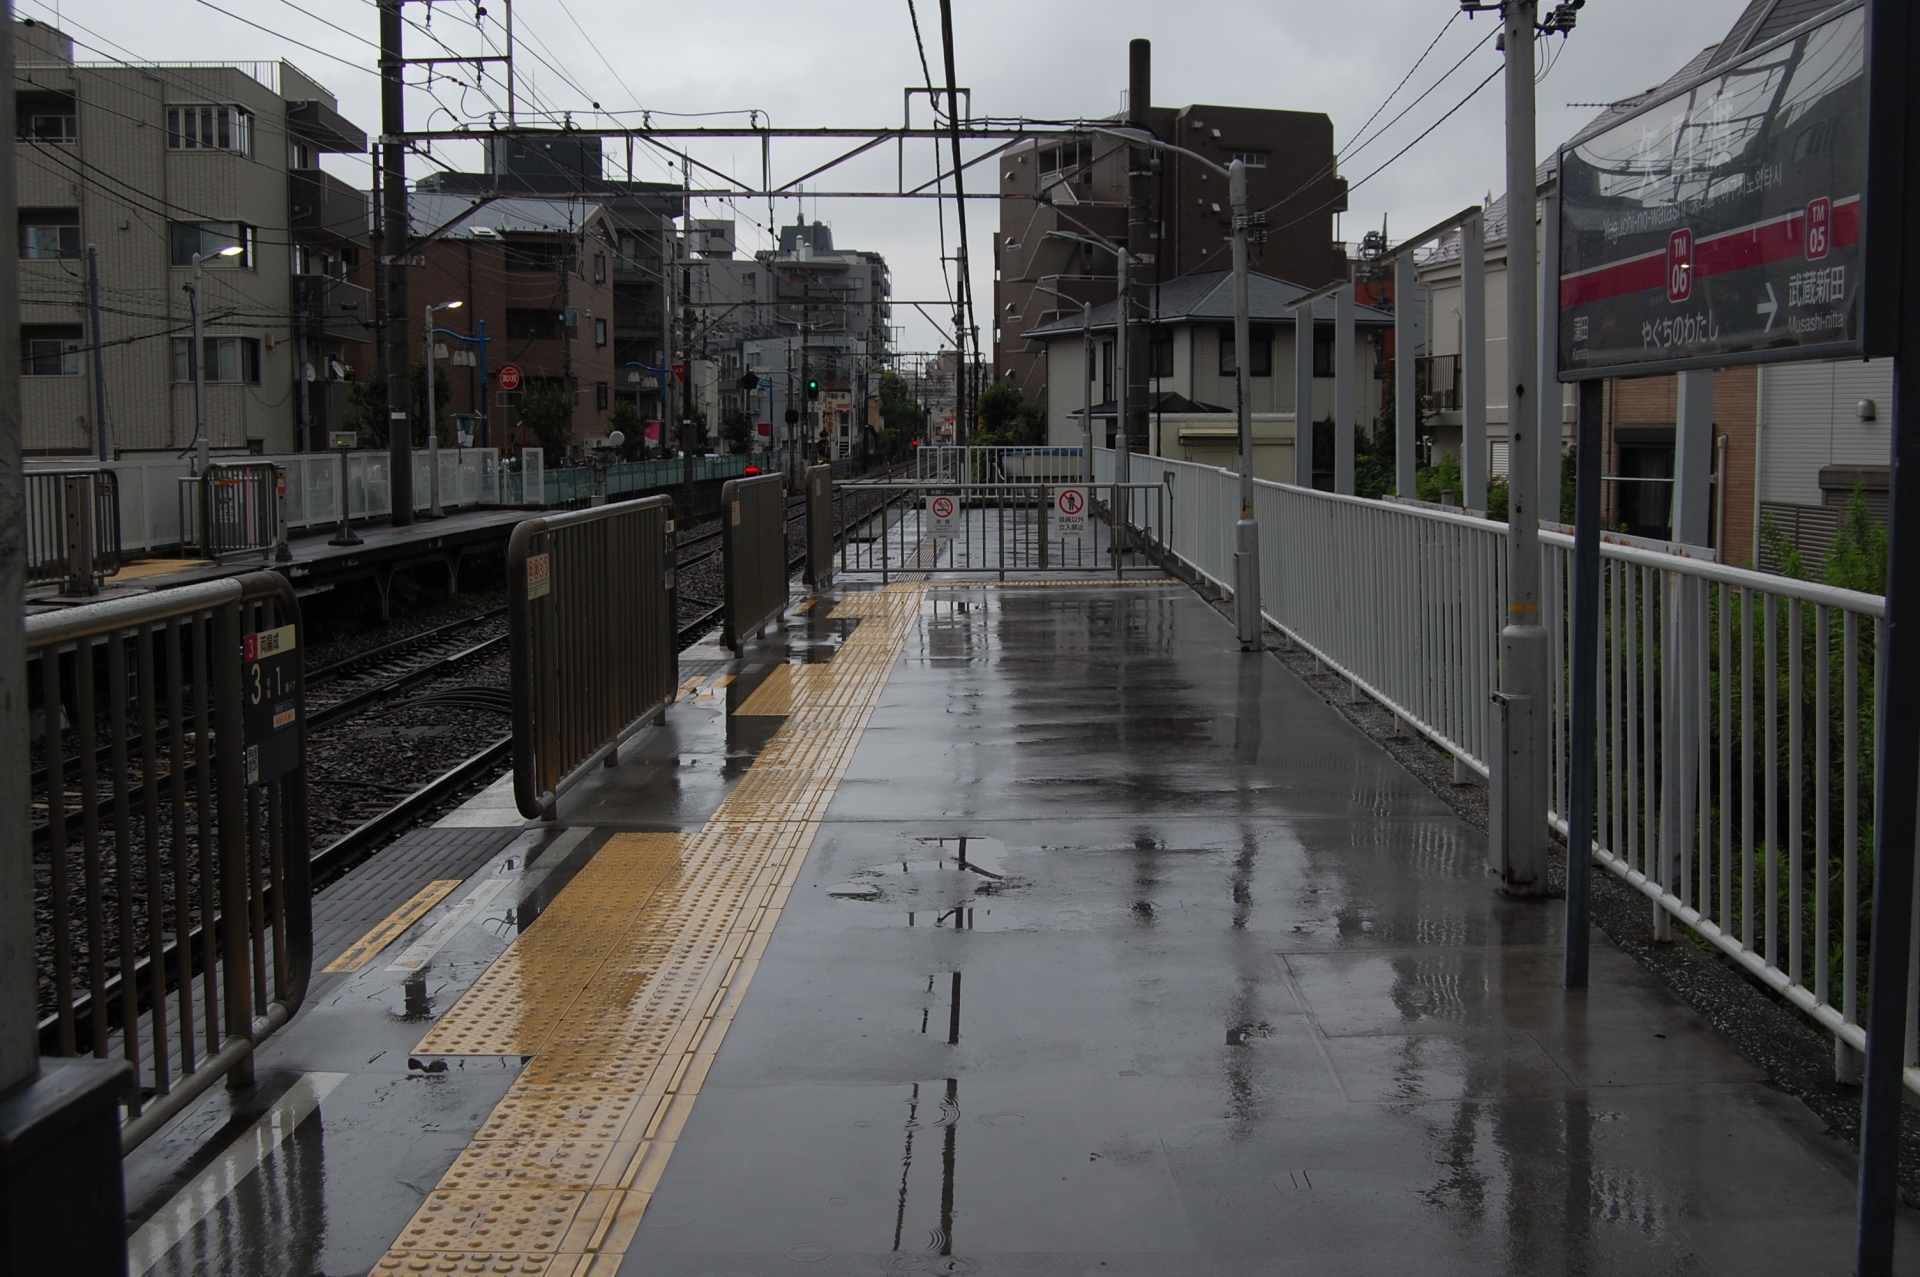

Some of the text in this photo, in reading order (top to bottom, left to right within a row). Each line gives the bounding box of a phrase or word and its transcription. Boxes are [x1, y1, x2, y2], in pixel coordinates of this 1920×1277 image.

[1637, 90, 1734, 198] 矢口渡
[1812, 204, 1825, 224] TM
[1674, 237, 1688, 259] TM
[1809, 226, 1826, 254] 05
[1672, 262, 1688, 295] 06
[1788, 265, 1845, 308] 武蔵新田
[1641, 309, 1719, 350] やぐちのわたし
[1787, 309, 1844, 333] Musashi-nitta
[248, 639, 254, 658] 3
[252, 663, 262, 705] 3
[276, 666, 281, 696] 1
